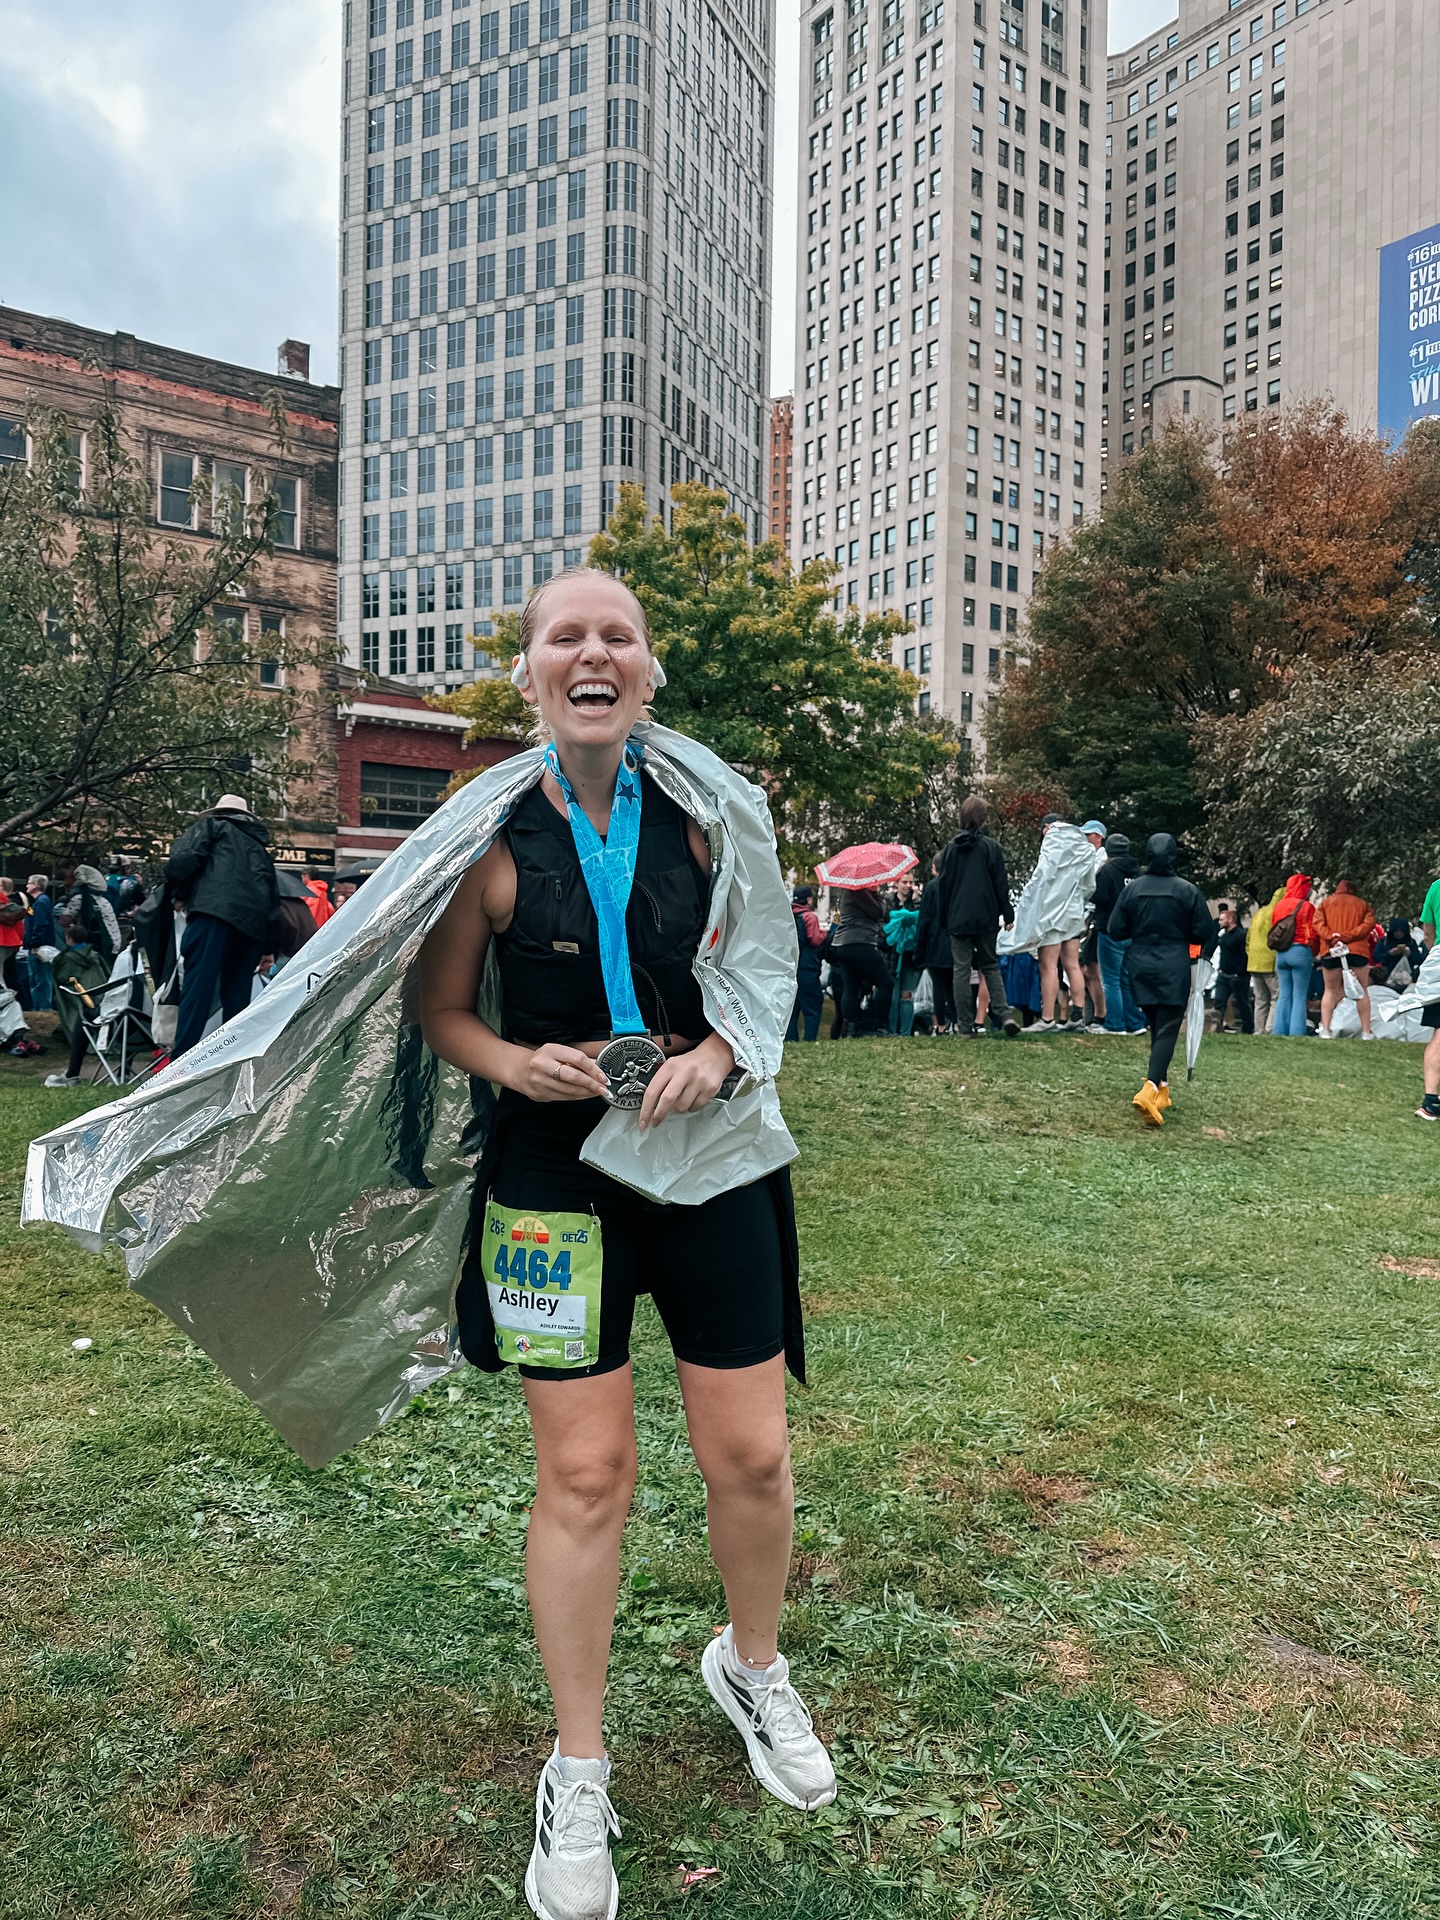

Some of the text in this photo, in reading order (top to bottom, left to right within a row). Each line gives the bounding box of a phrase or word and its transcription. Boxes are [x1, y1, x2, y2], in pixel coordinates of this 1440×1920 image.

[1407, 246, 1430, 264] #16
[1409, 303, 1440, 331] COR
[1408, 345, 1424, 361] #1
[731, 999, 748, 1028] WIND,
[189, 1053, 208, 1068] Silver
[208, 1044, 223, 1056] Side
[223, 1035, 238, 1046] Out
[494, 1244, 572, 1291] 4464
[498, 1287, 560, 1317] Ashley
